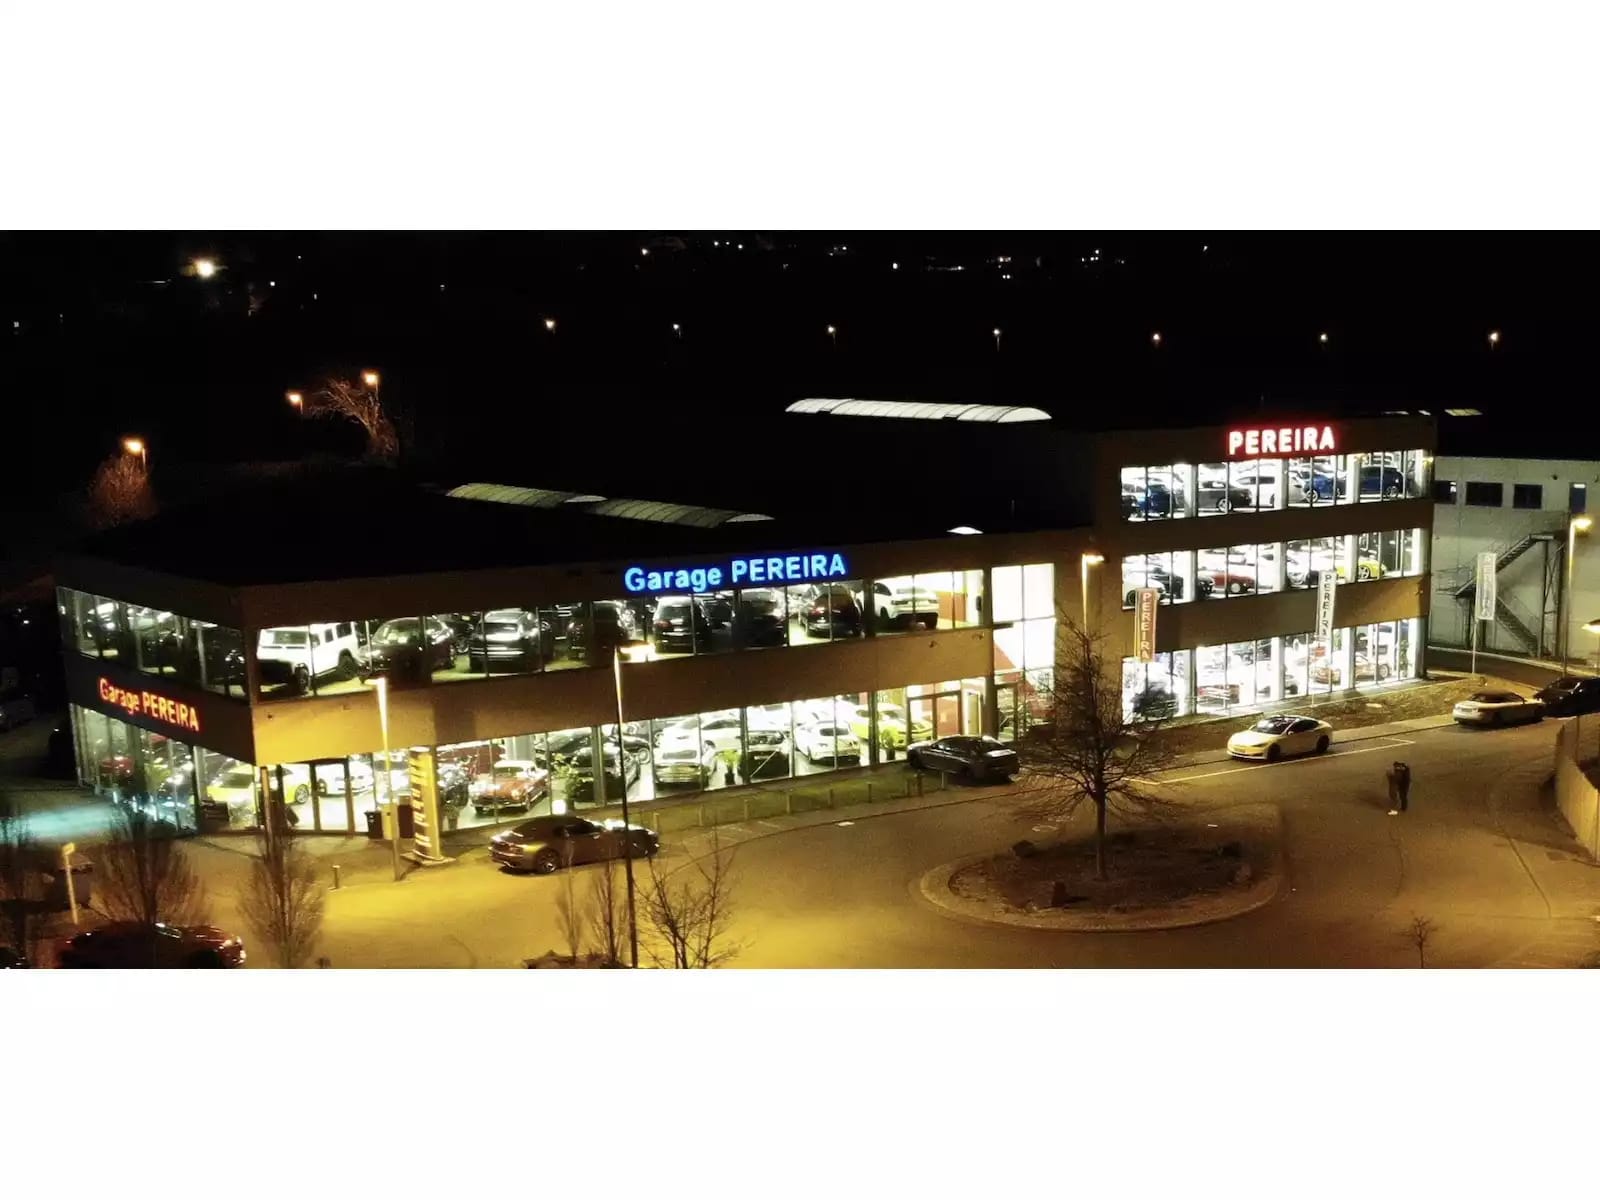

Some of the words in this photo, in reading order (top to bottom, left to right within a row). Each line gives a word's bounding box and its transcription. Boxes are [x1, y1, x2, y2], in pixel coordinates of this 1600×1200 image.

[1228, 425, 1336, 456] PEREIRA
[624, 566, 722, 593] Garage
[731, 553, 847, 584] PEREIRA
[1140, 591, 1153, 660] PEREIRA
[99, 677, 140, 715] Garage
[141, 691, 200, 732] PEREIRA
